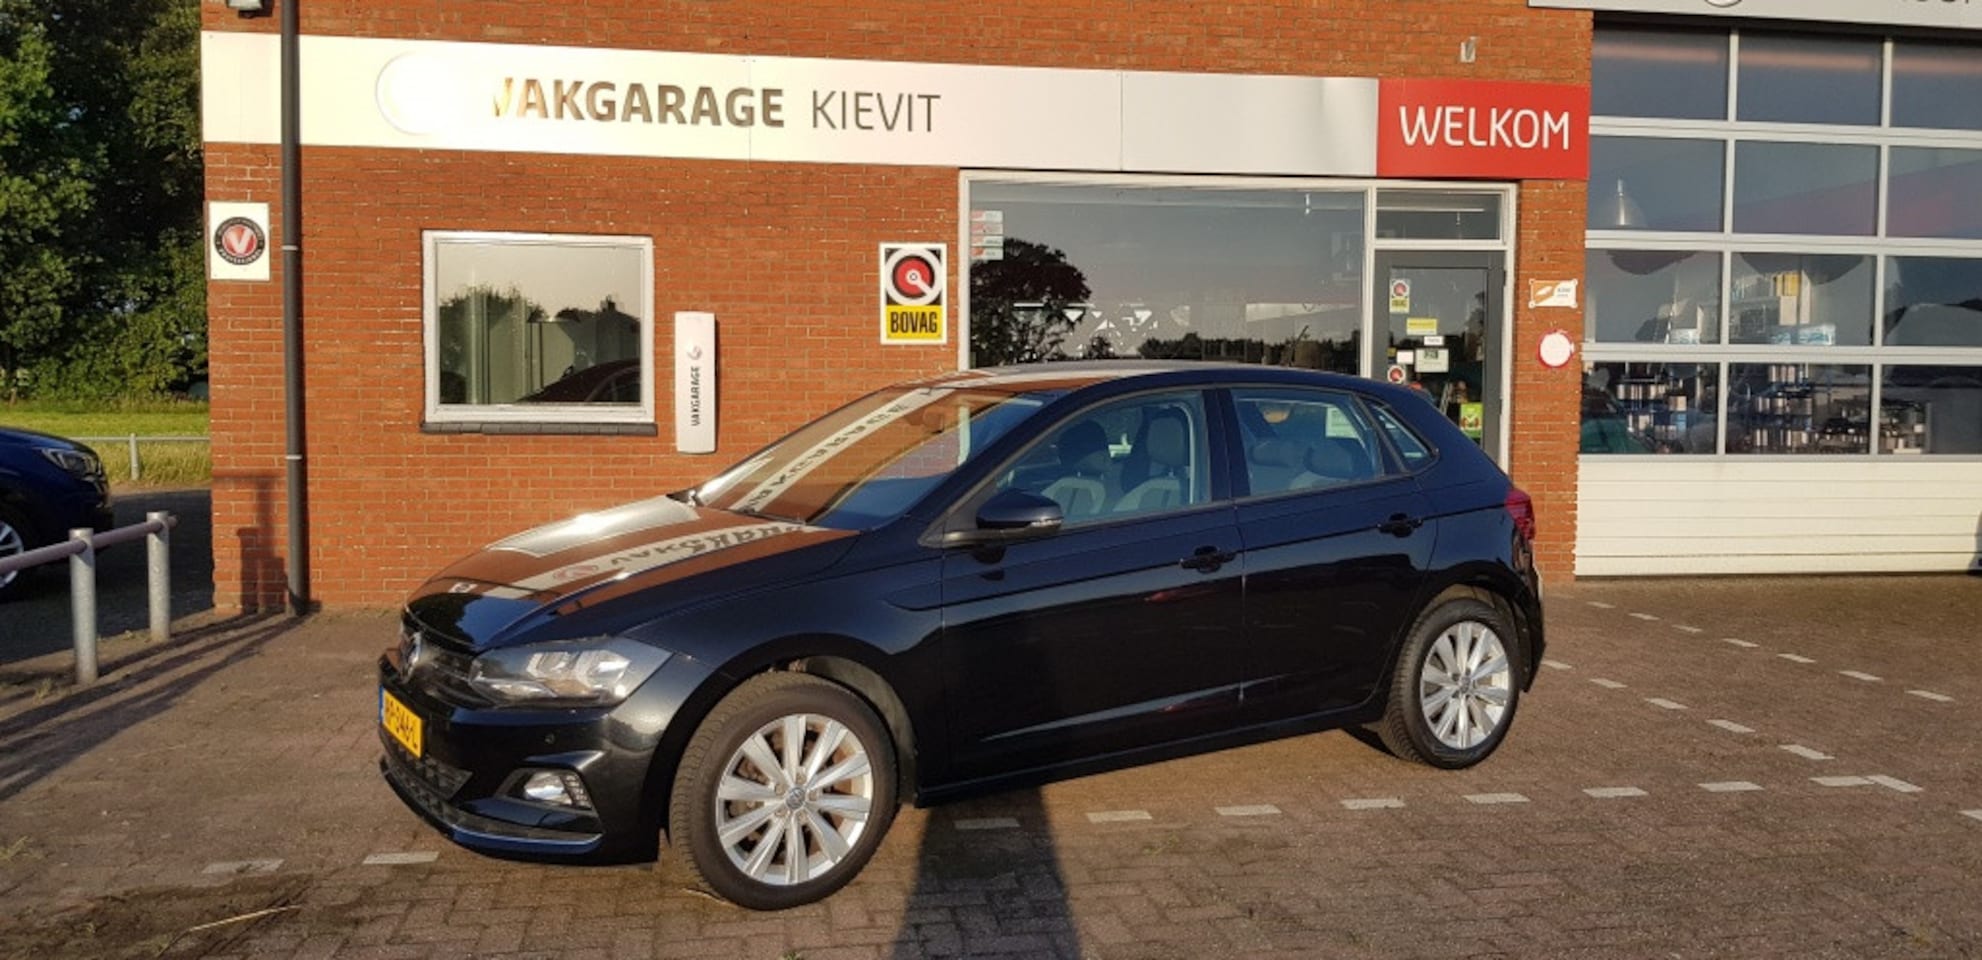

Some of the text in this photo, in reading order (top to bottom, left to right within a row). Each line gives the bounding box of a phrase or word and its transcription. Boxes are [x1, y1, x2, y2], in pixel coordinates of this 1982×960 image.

[811, 90, 941, 132] KIEVIT
[1399, 105, 1570, 150] WELKOM
[890, 311, 937, 333] BOVAG
